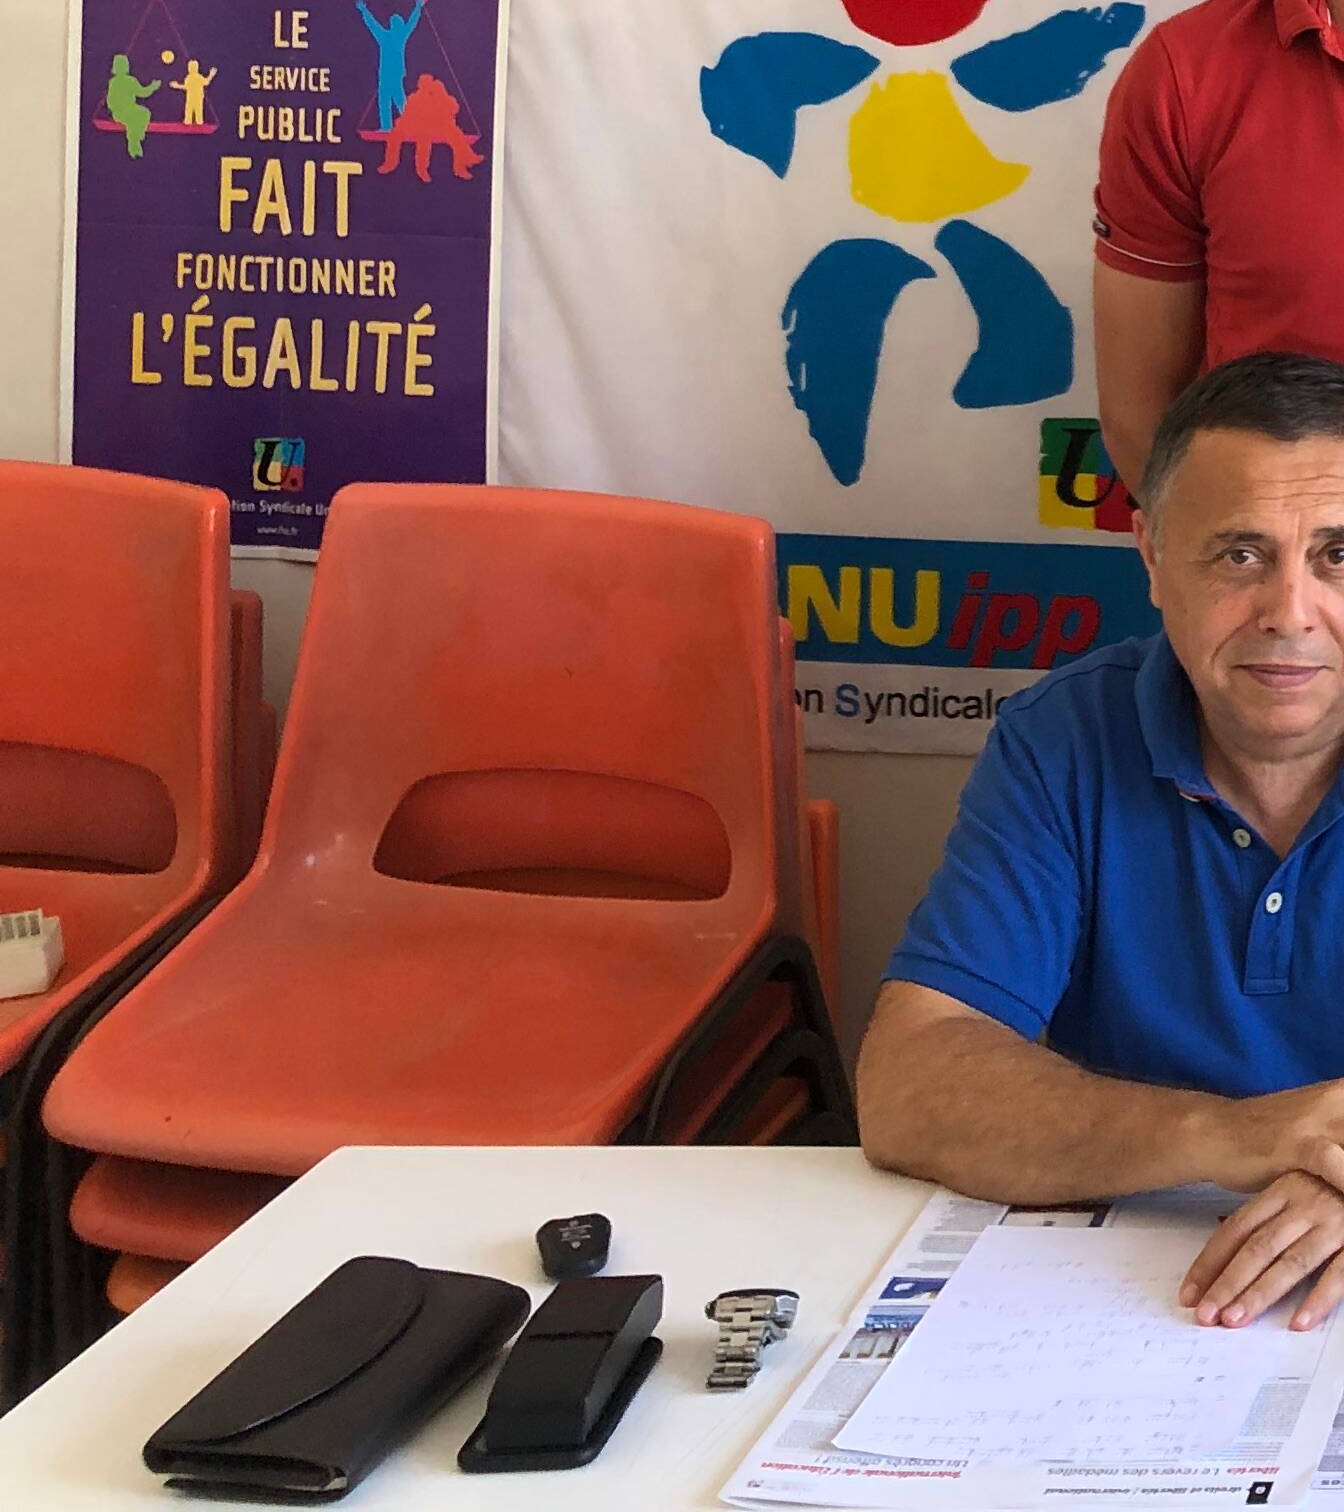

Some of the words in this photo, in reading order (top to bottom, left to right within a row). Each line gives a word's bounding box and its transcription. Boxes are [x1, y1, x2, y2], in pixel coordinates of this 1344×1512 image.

[273, 9, 310, 50] LE
[249, 67, 330, 93] SERVICE
[237, 105, 343, 144] PUBLIC
[219, 155, 363, 237] FAIT
[176, 252, 397, 298] FONCTIONNER
[130, 294, 436, 397] L'ÉGALITÉ
